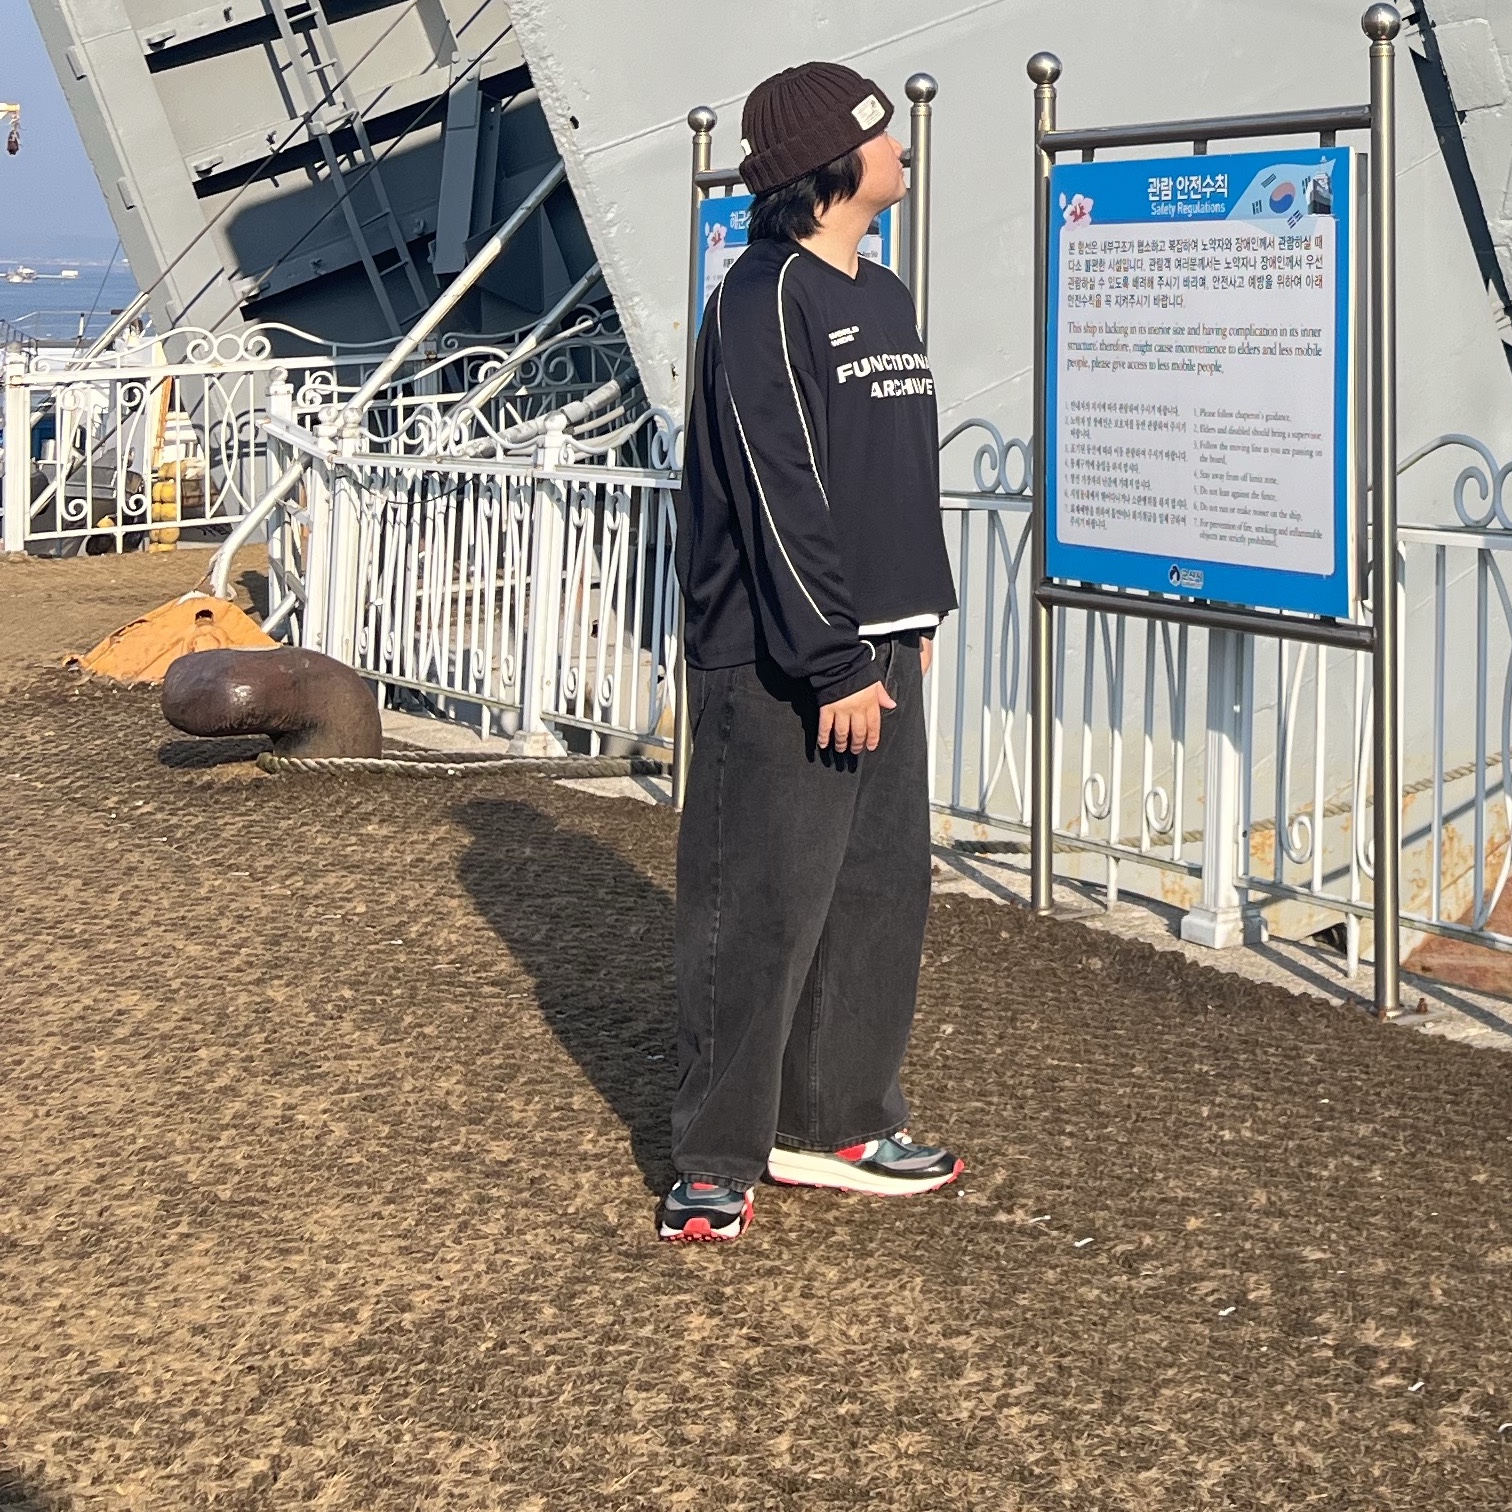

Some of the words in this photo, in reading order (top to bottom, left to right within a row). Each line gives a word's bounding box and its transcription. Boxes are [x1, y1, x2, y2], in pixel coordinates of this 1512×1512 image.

[1147, 176, 1173, 201] 관람
[1176, 173, 1227, 200] 안전수칙
[1150, 201, 1176, 217] Safety
[1177, 200, 1225, 217] Regulations
[1277, 234, 1311, 251] 관람하실
[1305, 254, 1323, 270] 우선
[1276, 273, 1302, 289] 위하여
[1305, 273, 1323, 289] 아래
[1066, 320, 1082, 333] This
[871, 377, 933, 399] ARCHIVE
